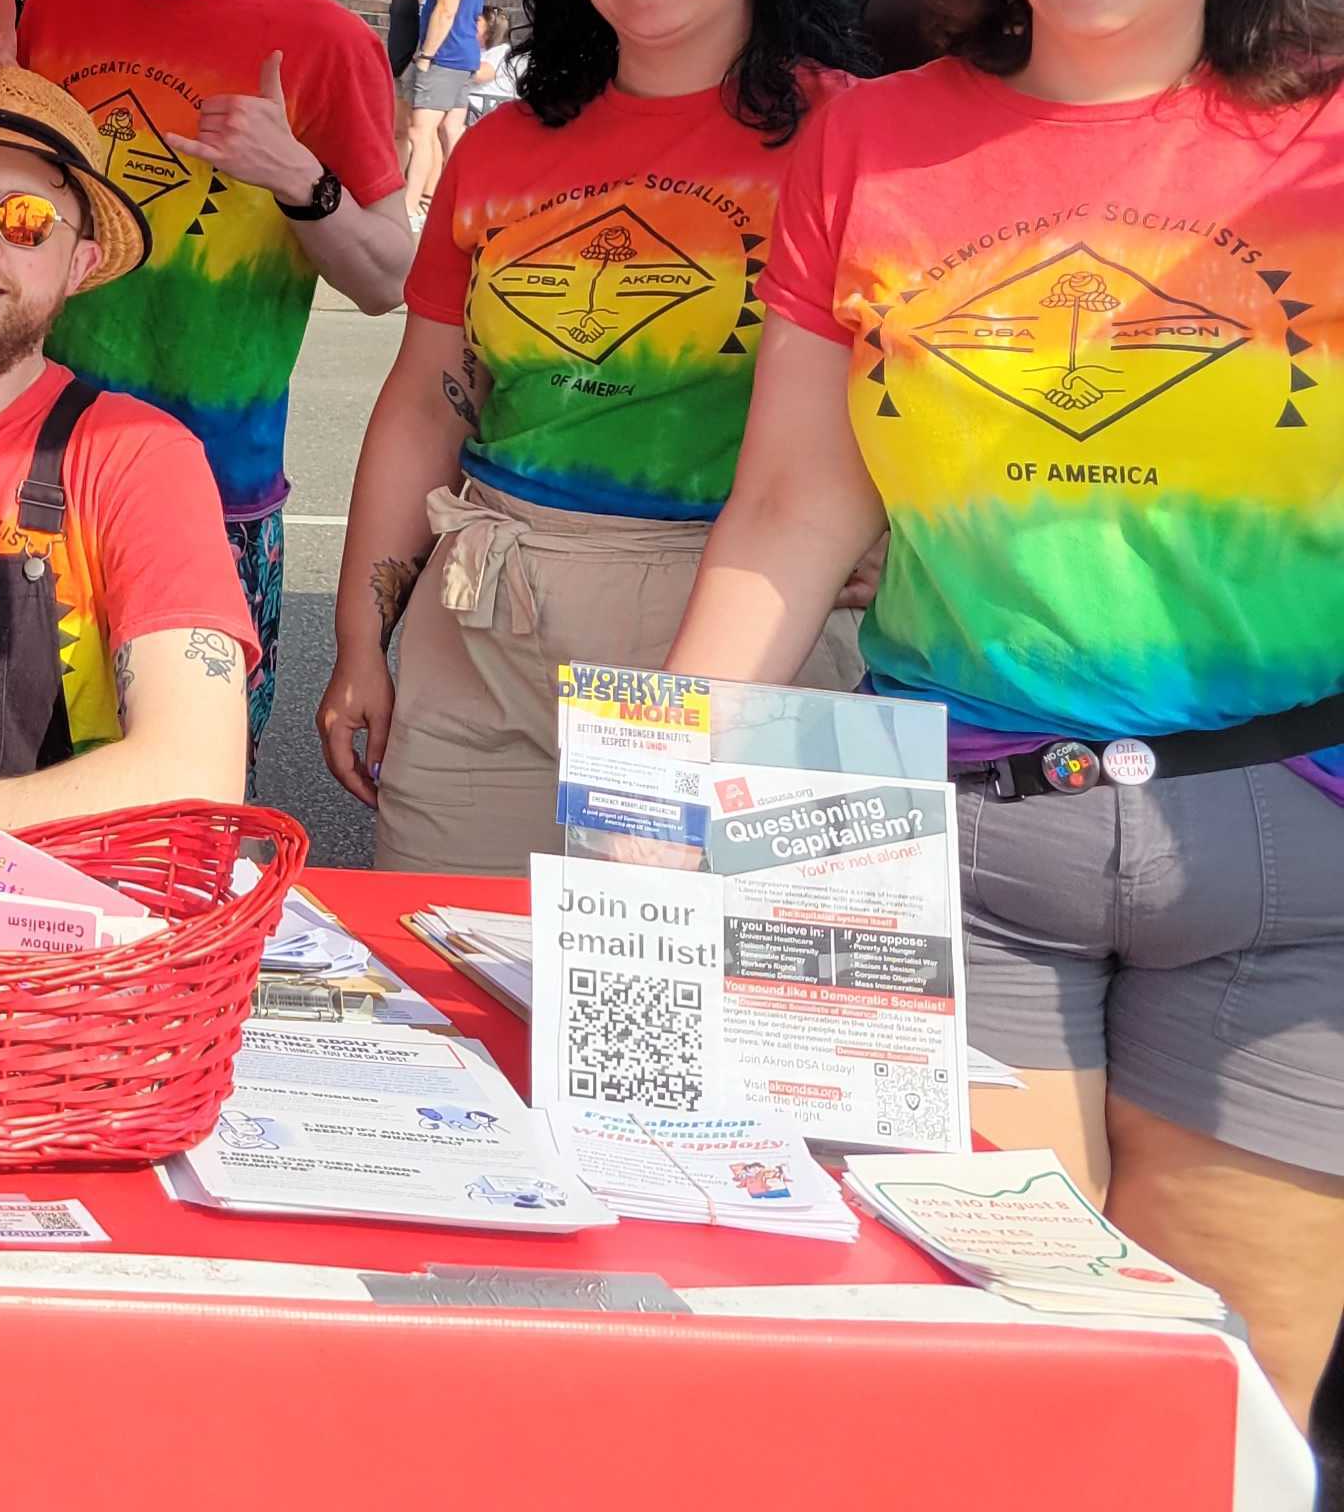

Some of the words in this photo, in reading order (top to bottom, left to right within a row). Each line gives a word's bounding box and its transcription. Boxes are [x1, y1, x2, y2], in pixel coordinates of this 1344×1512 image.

[62, 61, 141, 88] EMOCRATIC
[145, 67, 207, 110] SOCIALIS
[124, 158, 177, 178] AKRON
[645, 174, 750, 228] SOCIALISTS
[927, 202, 1090, 281] DEMOCRATIC
[1104, 202, 1263, 265] SOCIALISTS
[527, 275, 570, 287] DSA
[619, 275, 691, 285] AKRON
[974, 328, 1036, 340] DSA
[1112, 325, 1221, 338] AKRON
[551, 374, 570, 388] OF
[1007, 462, 1038, 483] OF
[1048, 463, 1159, 486] AMERICA
[572, 666, 710, 695] WORKERS
[558, 681, 684, 708] DESERVE
[619, 703, 700, 726] MORE
[1043, 752, 1056, 762] NO
[1116, 744, 1137, 753] DIE
[1106, 754, 1150, 765] YUPPIE
[1112, 767, 1149, 777] SCUM
[725, 796, 886, 843] Questioning
[771, 809, 924, 858] Capitalism?
[849, 854, 873, 868] not
[876, 843, 923, 863] alone!
[558, 889, 627, 919] Join
[639, 897, 695, 926] our
[8, 916, 84, 937] Capitalism
[730, 919, 738, 929] If
[741, 922, 761, 933] you
[766, 922, 807, 936] believe
[809, 926, 825, 937] in:
[557, 926, 644, 962] email
[656, 935, 718, 967] list!
[844, 930, 852, 940] If
[855, 932, 877, 944] you
[880, 933, 928, 948] oppose:
[725, 981, 745, 993] You
[748, 983, 785, 995] sound
[787, 986, 807, 999] like
[810, 991, 817, 999] a
[820, 990, 888, 1006] Democratic
[890, 997, 946, 1011] Socialist!
[316, 1038, 379, 1047] ABOUT
[319, 1044, 371, 1054] YOUR
[373, 1049, 420, 1058] JOB?
[738, 1054, 760, 1064] Join
[763, 1057, 794, 1067] Akron
[797, 1060, 819, 1071] DSA
[821, 1062, 855, 1075] today!
[744, 1079, 767, 1089] Visit
[770, 1082, 840, 1099] akrondsa.org
[746, 1092, 771, 1103] scan
[644, 1119, 762, 1128] abortion.
[955, 1199, 983, 1208] NO
[989, 1200, 1056, 1211] August
[993, 1213, 1095, 1226] Democracy
